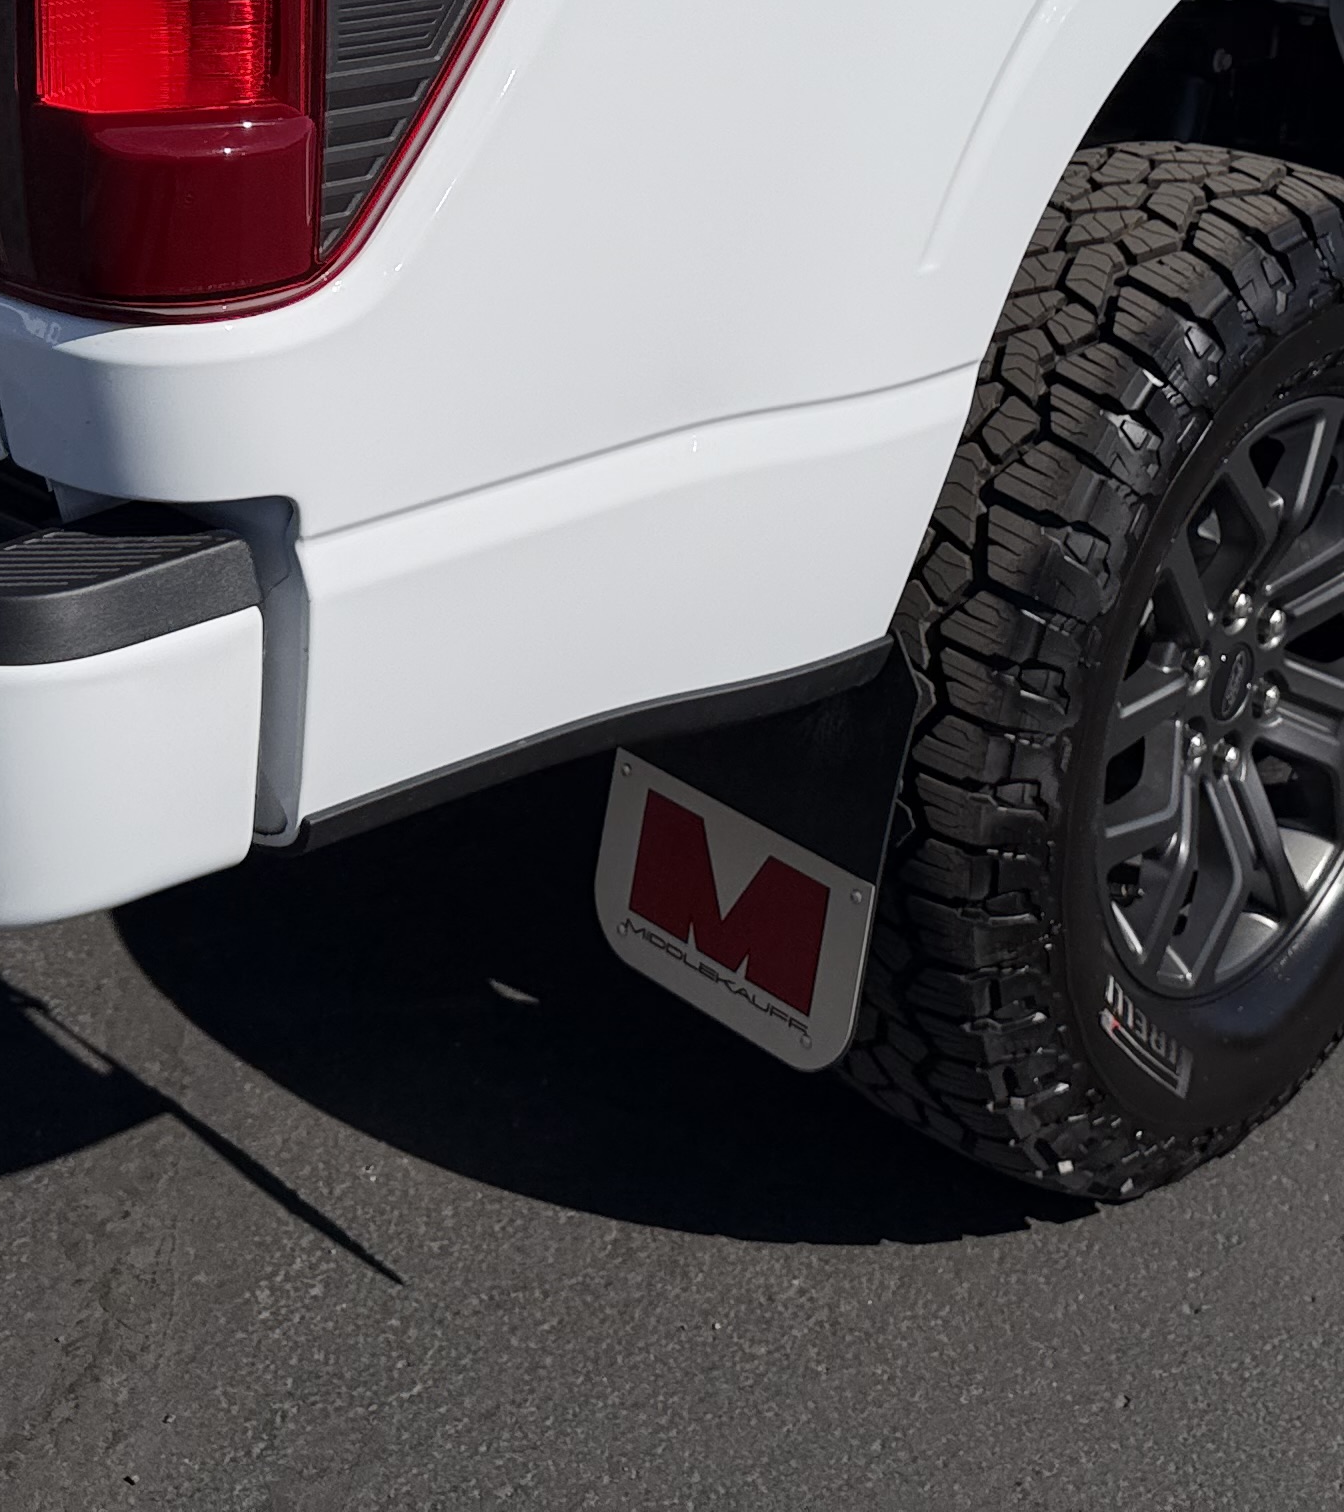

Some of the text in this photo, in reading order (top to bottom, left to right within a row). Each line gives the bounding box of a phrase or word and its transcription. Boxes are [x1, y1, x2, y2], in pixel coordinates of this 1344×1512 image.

[629, 788, 831, 1017] M
[624, 918, 809, 1034] MIDDLEKAUFF
[1099, 975, 1193, 1100] PIRELLI
